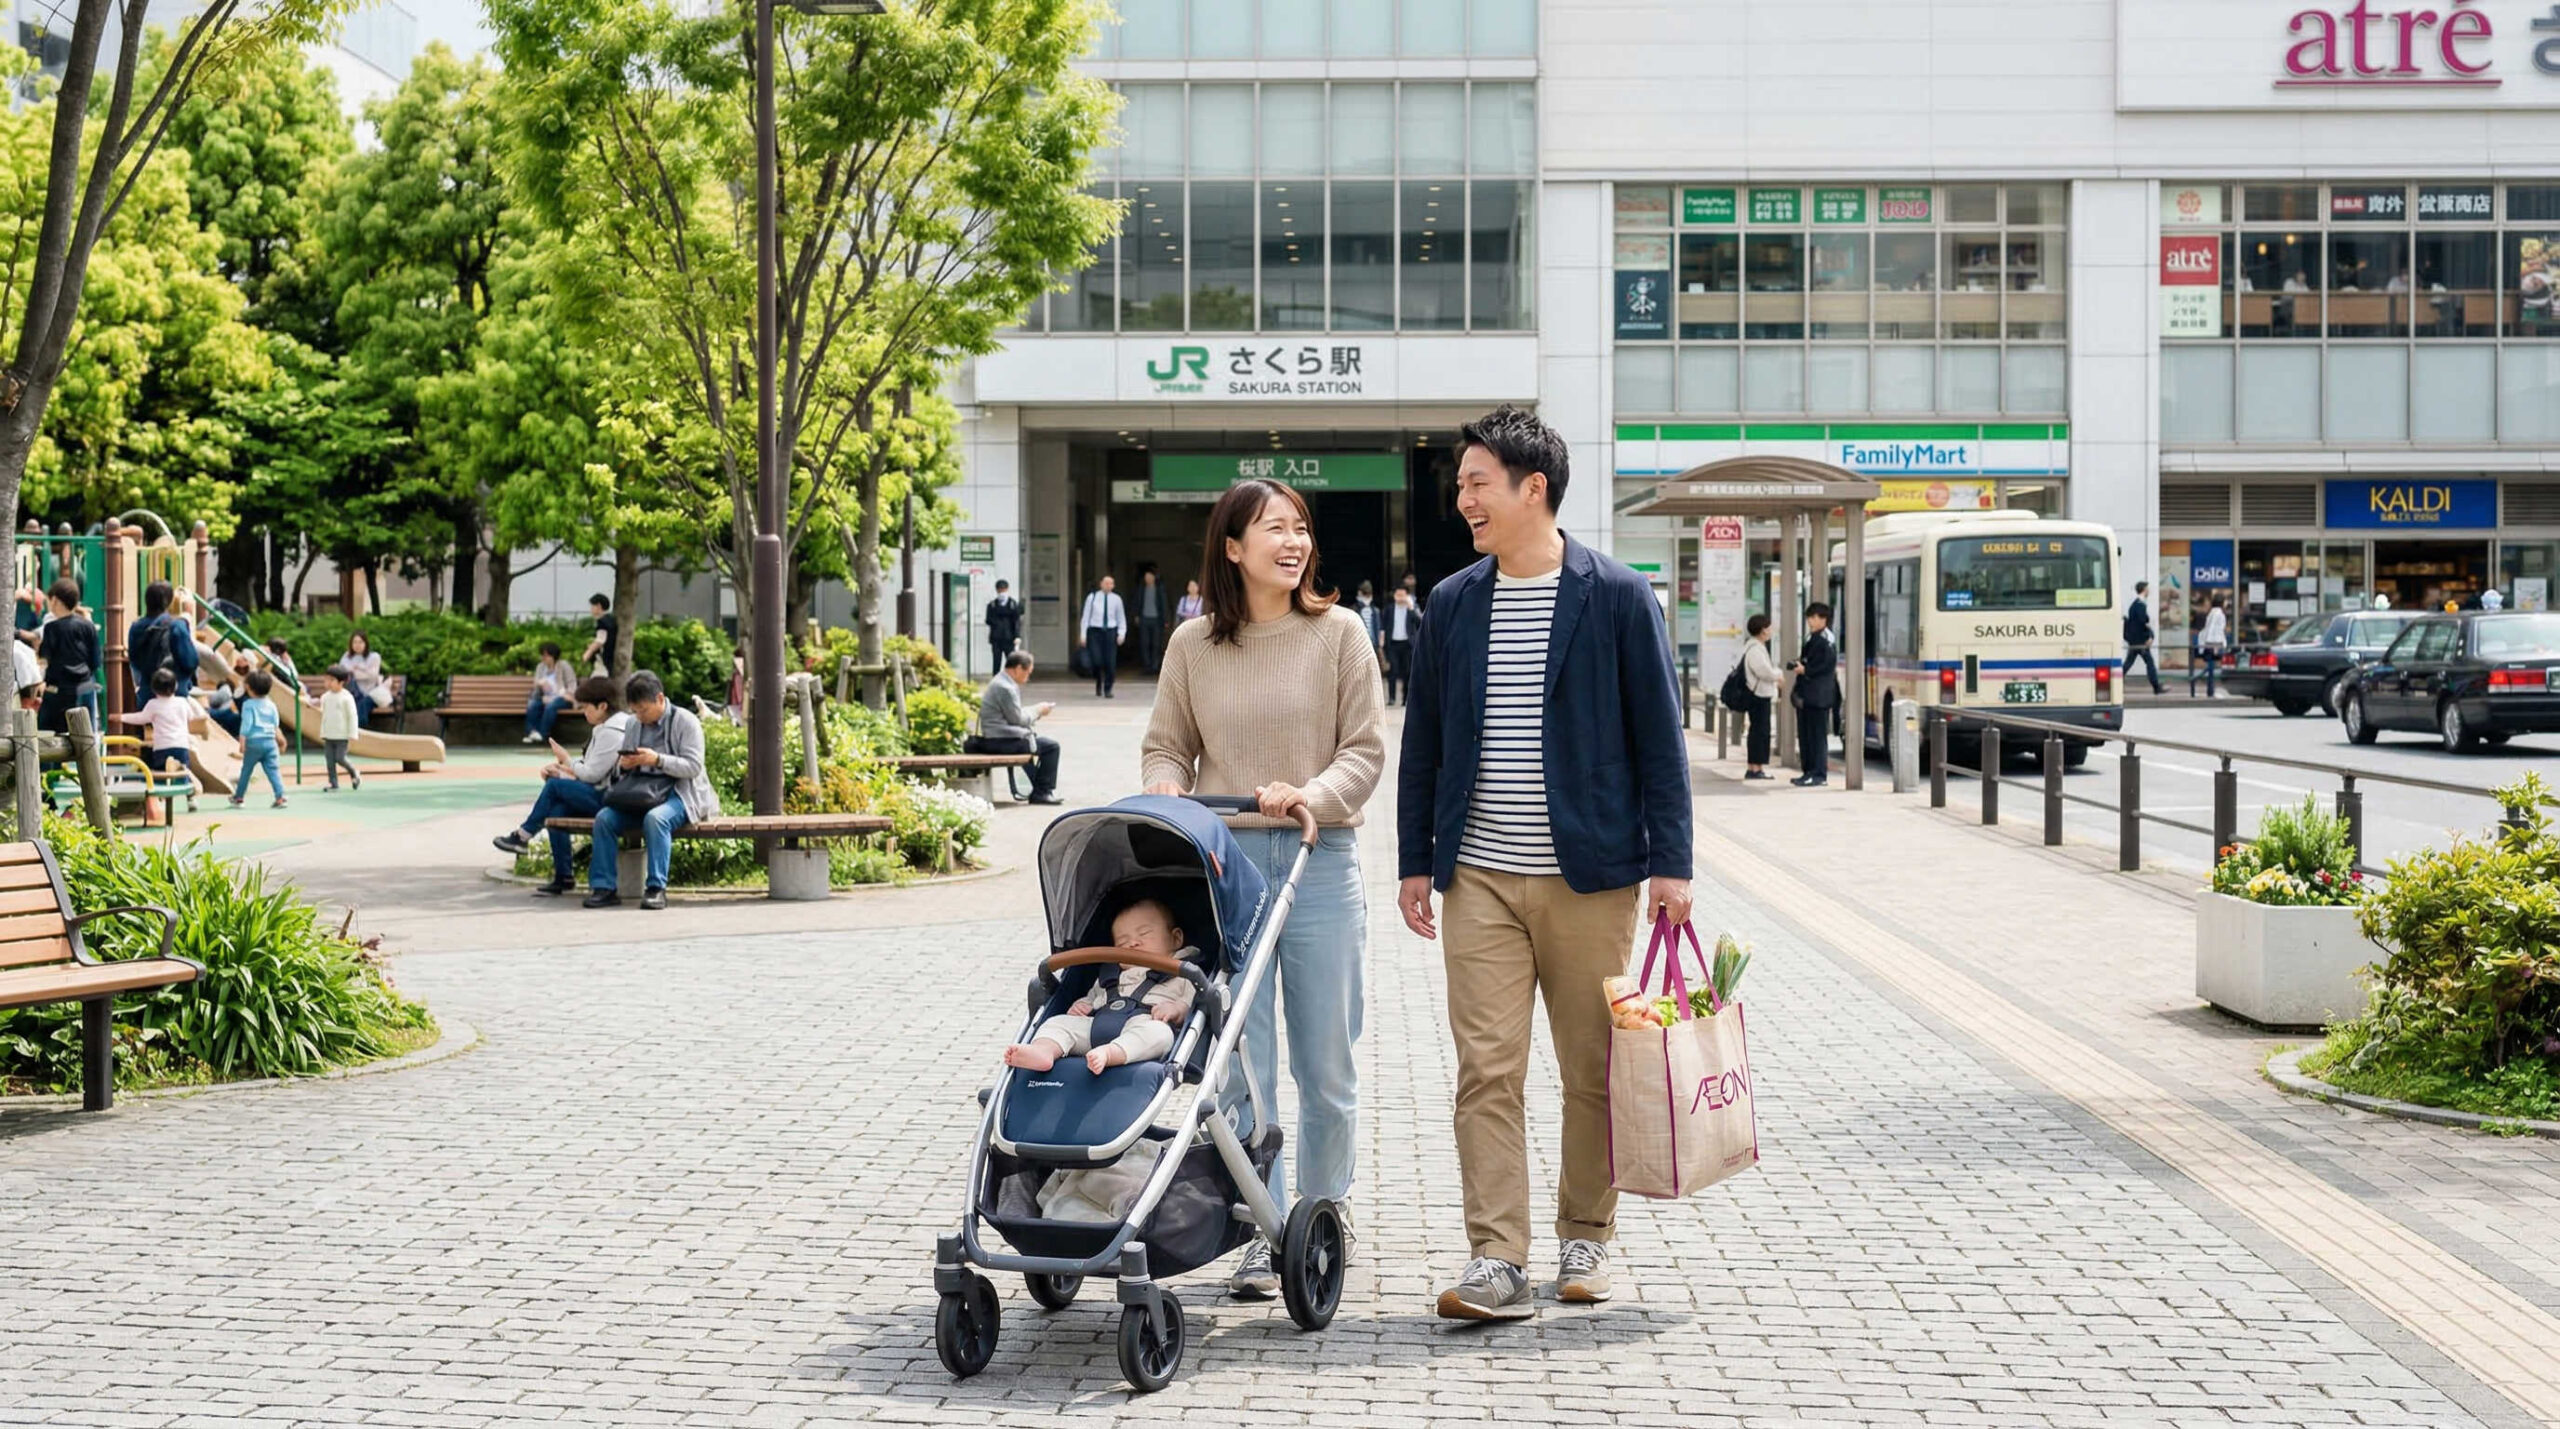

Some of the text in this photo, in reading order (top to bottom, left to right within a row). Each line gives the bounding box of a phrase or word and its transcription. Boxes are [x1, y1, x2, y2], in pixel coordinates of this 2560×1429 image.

[1147, 347, 1209, 380] JR
[1228, 347, 1362, 376] さくら駅
[1229, 381, 1362, 394] SAKURA STATION
[1284, 459, 1320, 475] 入口
[1842, 444, 1967, 468] FamilyMart
[2370, 486, 2450, 512] KALDI
[1974, 624, 2075, 638] SAKURA BUS
